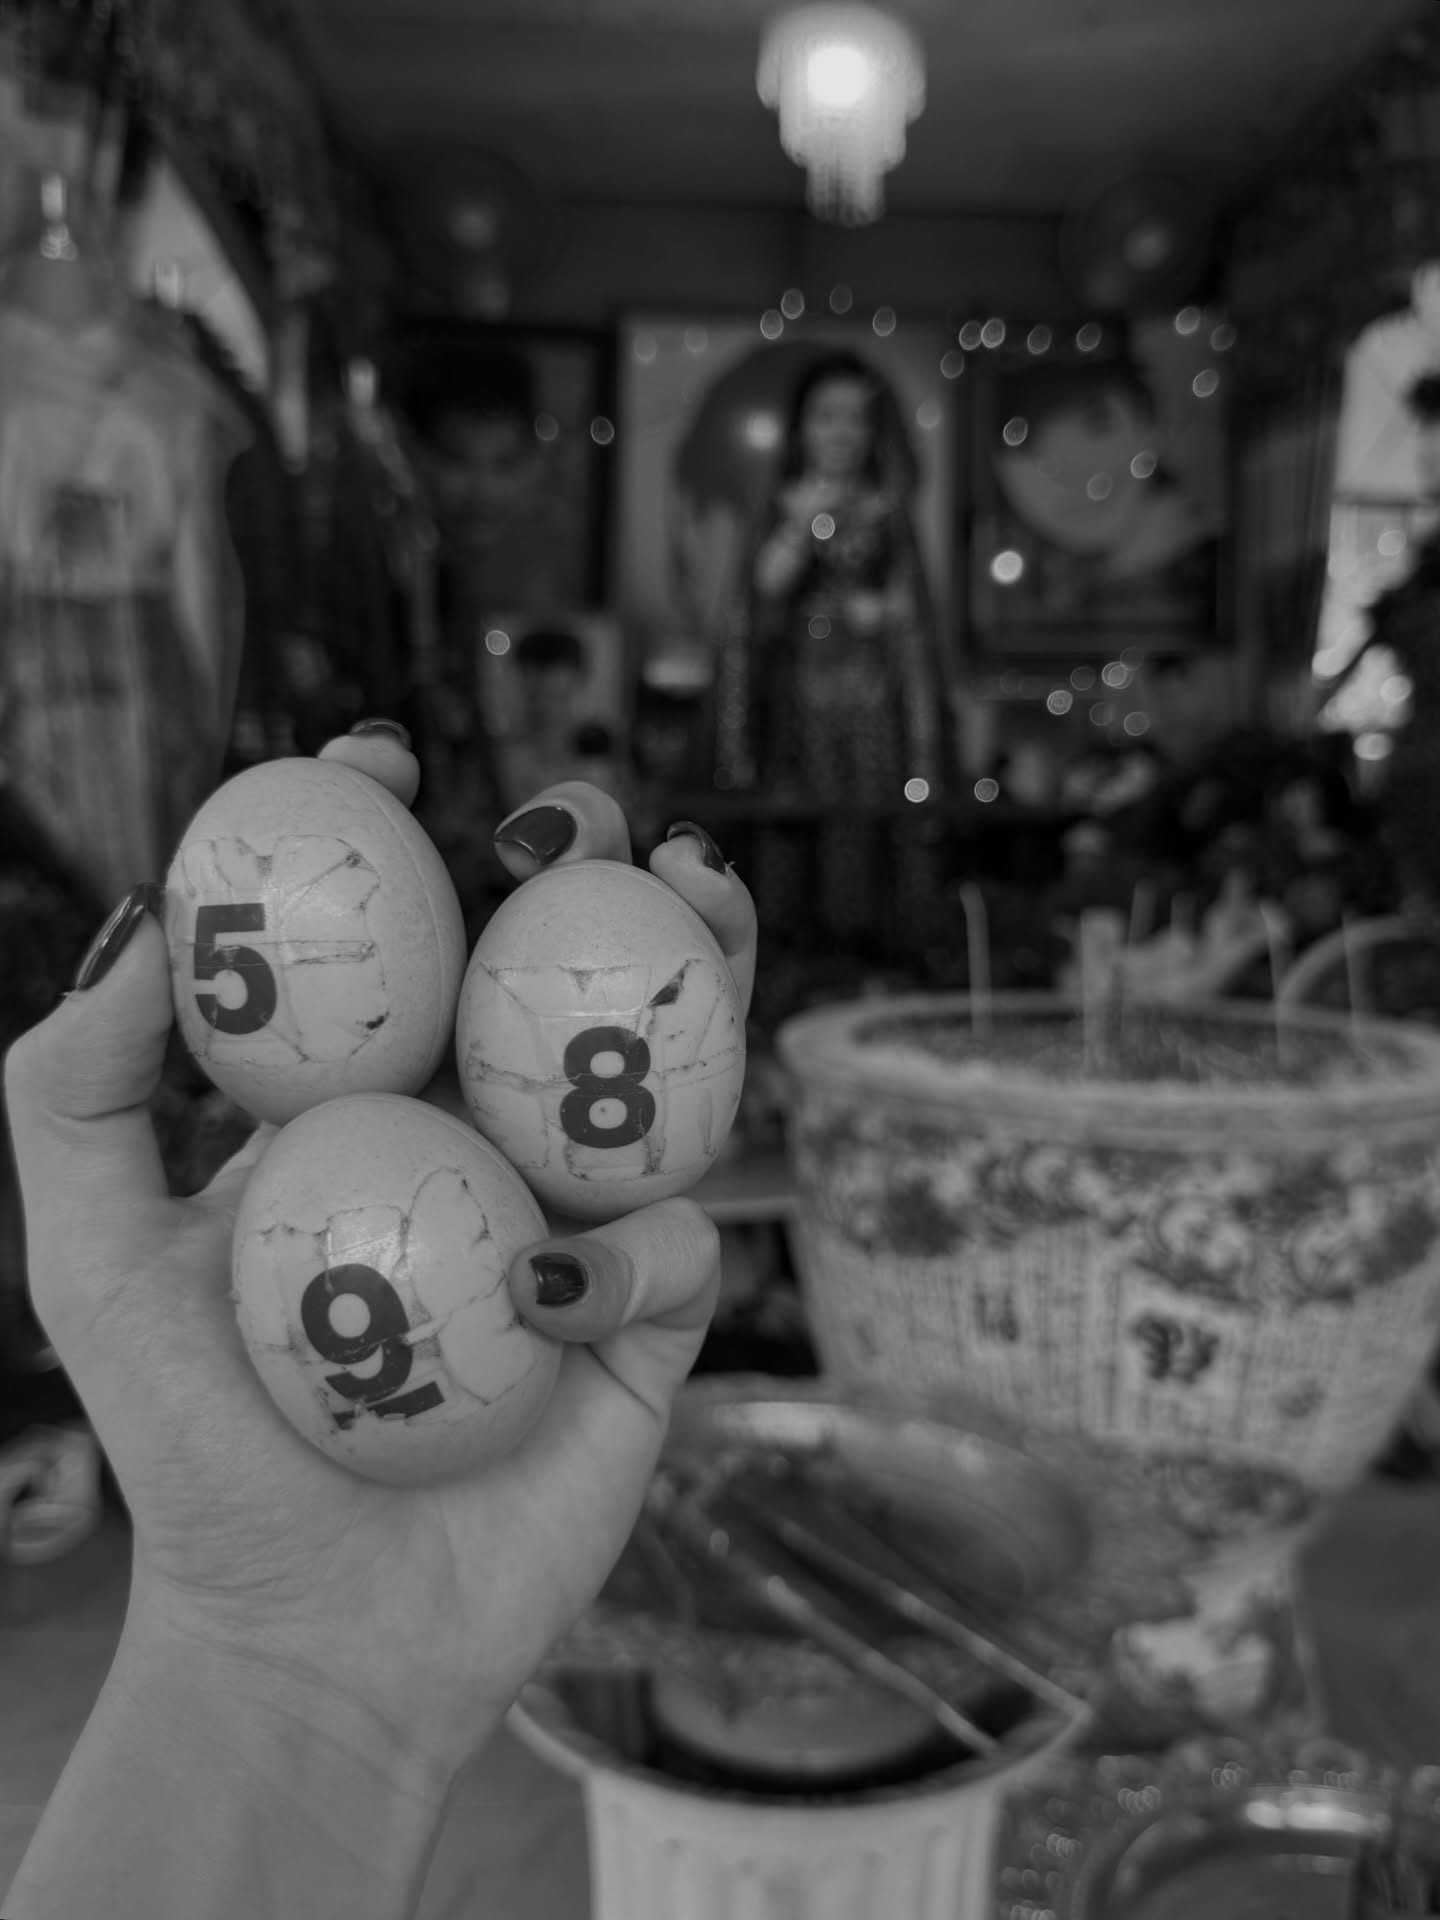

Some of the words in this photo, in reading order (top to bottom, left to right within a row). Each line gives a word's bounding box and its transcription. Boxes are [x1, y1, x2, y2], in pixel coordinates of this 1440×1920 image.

[194, 903, 276, 1034] 5
[560, 1026, 656, 1149] 8
[301, 1264, 414, 1403] 9
